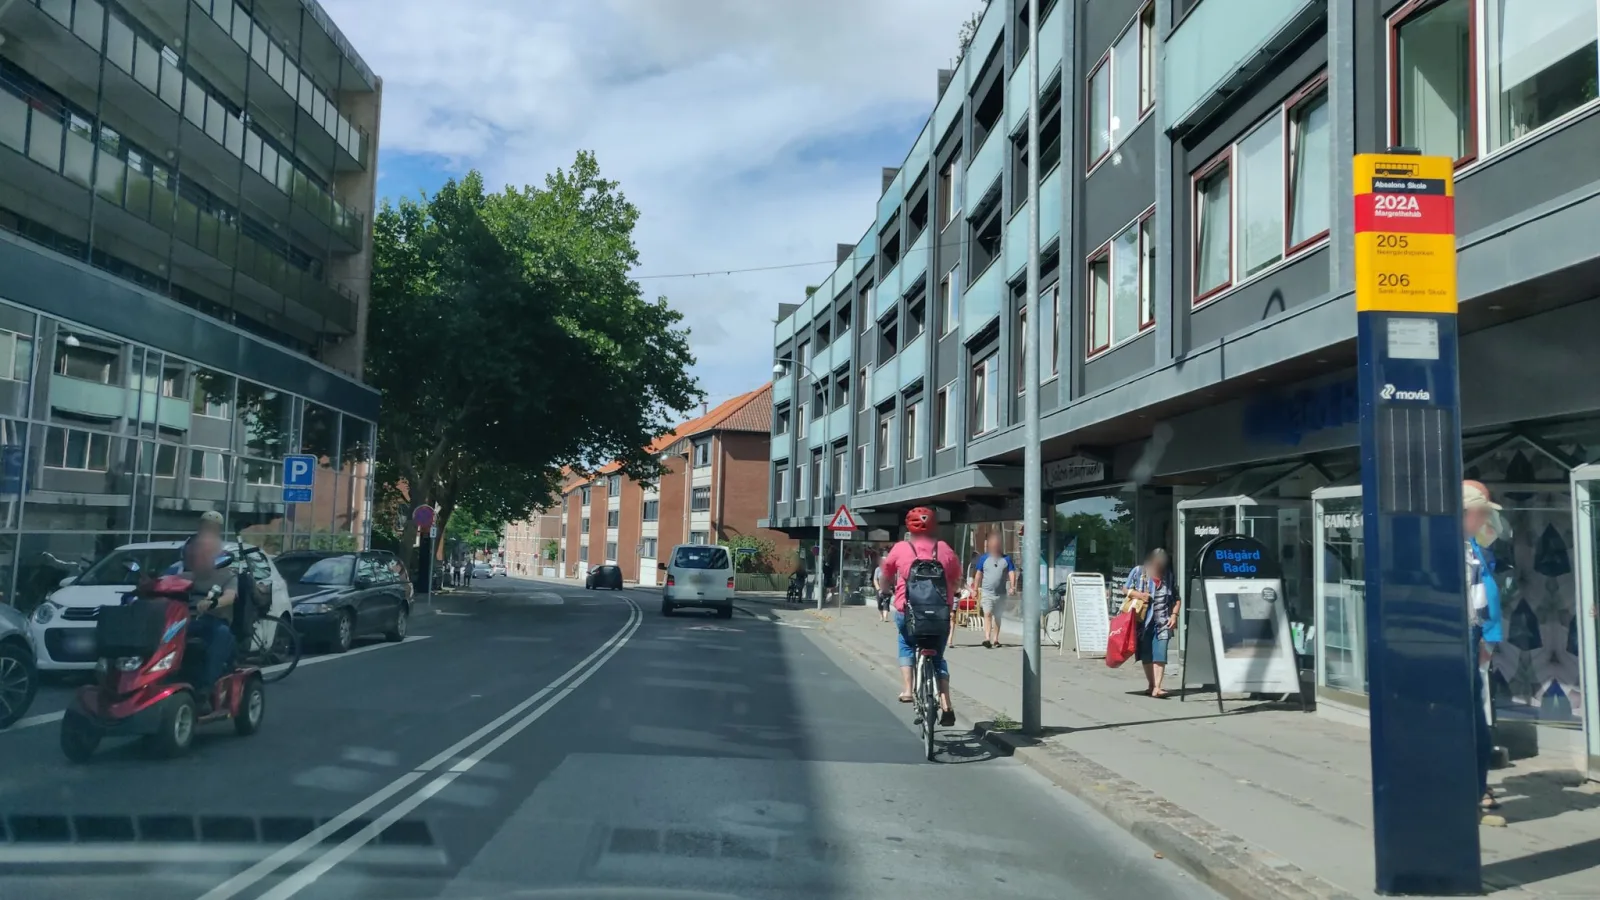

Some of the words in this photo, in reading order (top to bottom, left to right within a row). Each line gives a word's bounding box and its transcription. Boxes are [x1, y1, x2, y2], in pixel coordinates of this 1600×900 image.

[1374, 180, 1405, 189] Absalons
[1407, 182, 1427, 190] Skole
[1374, 195, 1419, 210] 202A
[1376, 234, 1408, 248] 205
[1378, 273, 1410, 287] 206
[1395, 388, 1430, 400] movia
[291, 460, 308, 482] P
[1324, 514, 1351, 528] BANG
[1215, 549, 1261, 562] Blågård
[1223, 562, 1257, 573] Radio
